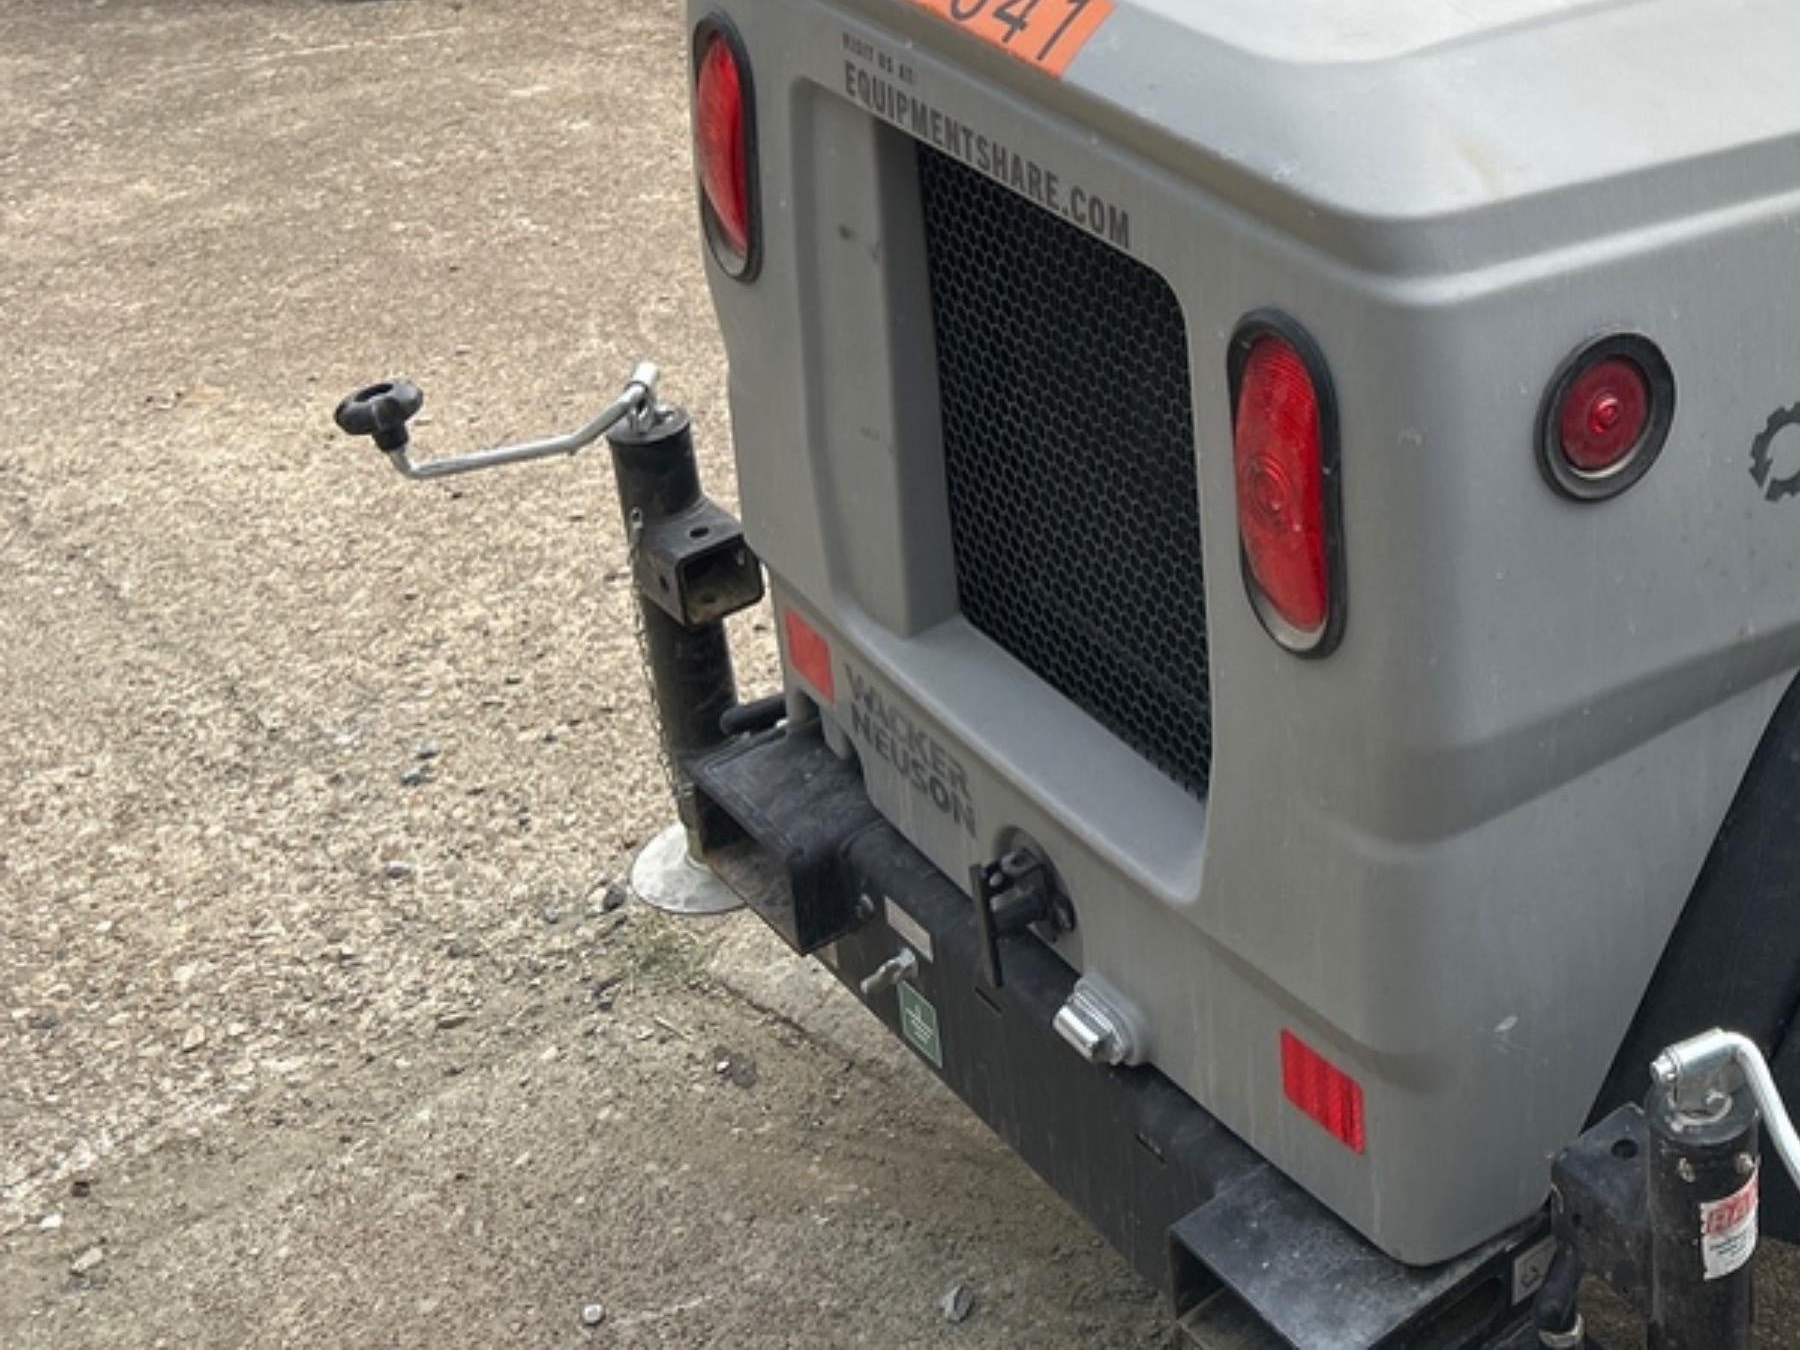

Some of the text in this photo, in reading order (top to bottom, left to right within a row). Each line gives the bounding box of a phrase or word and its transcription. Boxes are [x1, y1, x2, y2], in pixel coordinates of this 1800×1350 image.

[845, 59, 1130, 250] EQUIPMENTSHARE.COM
[846, 664, 971, 801] WACKER
[850, 711, 977, 838] NEUSON
